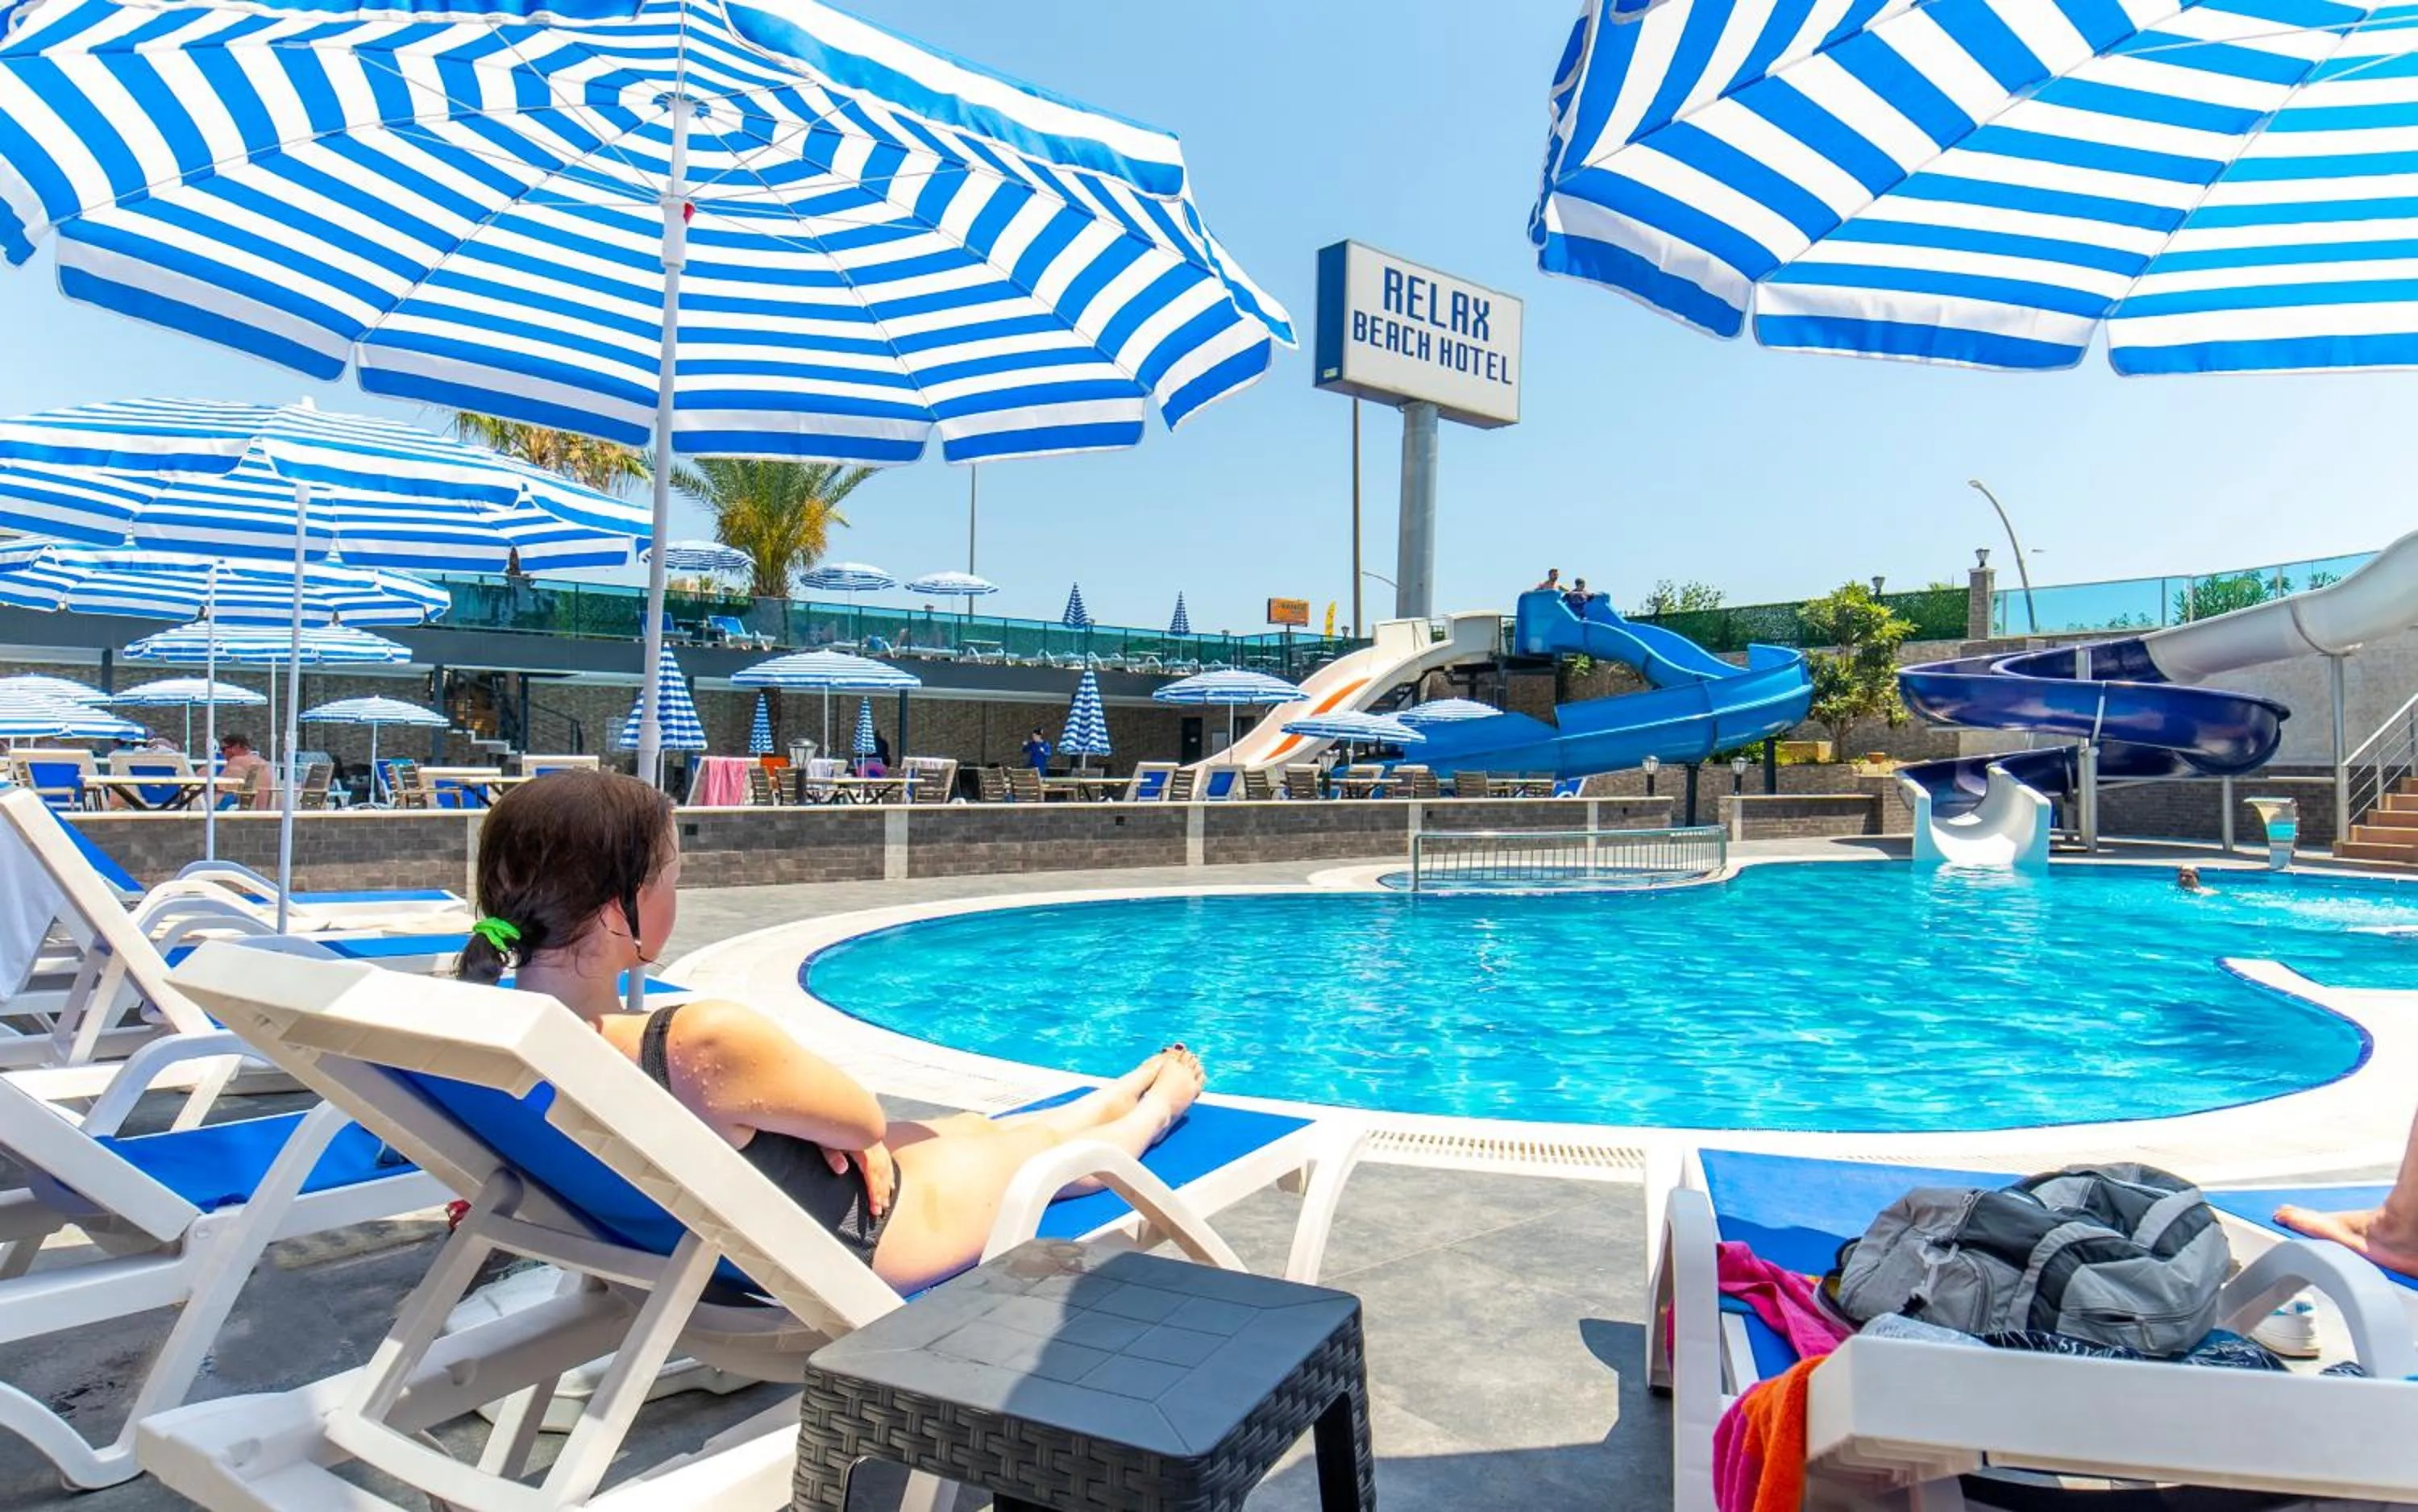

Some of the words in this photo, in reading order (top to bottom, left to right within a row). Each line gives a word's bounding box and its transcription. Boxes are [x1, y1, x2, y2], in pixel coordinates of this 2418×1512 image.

[1384, 266, 1490, 342] RELAX
[1353, 309, 1431, 362] BEACH
[1440, 336, 1513, 385] HOTEL
